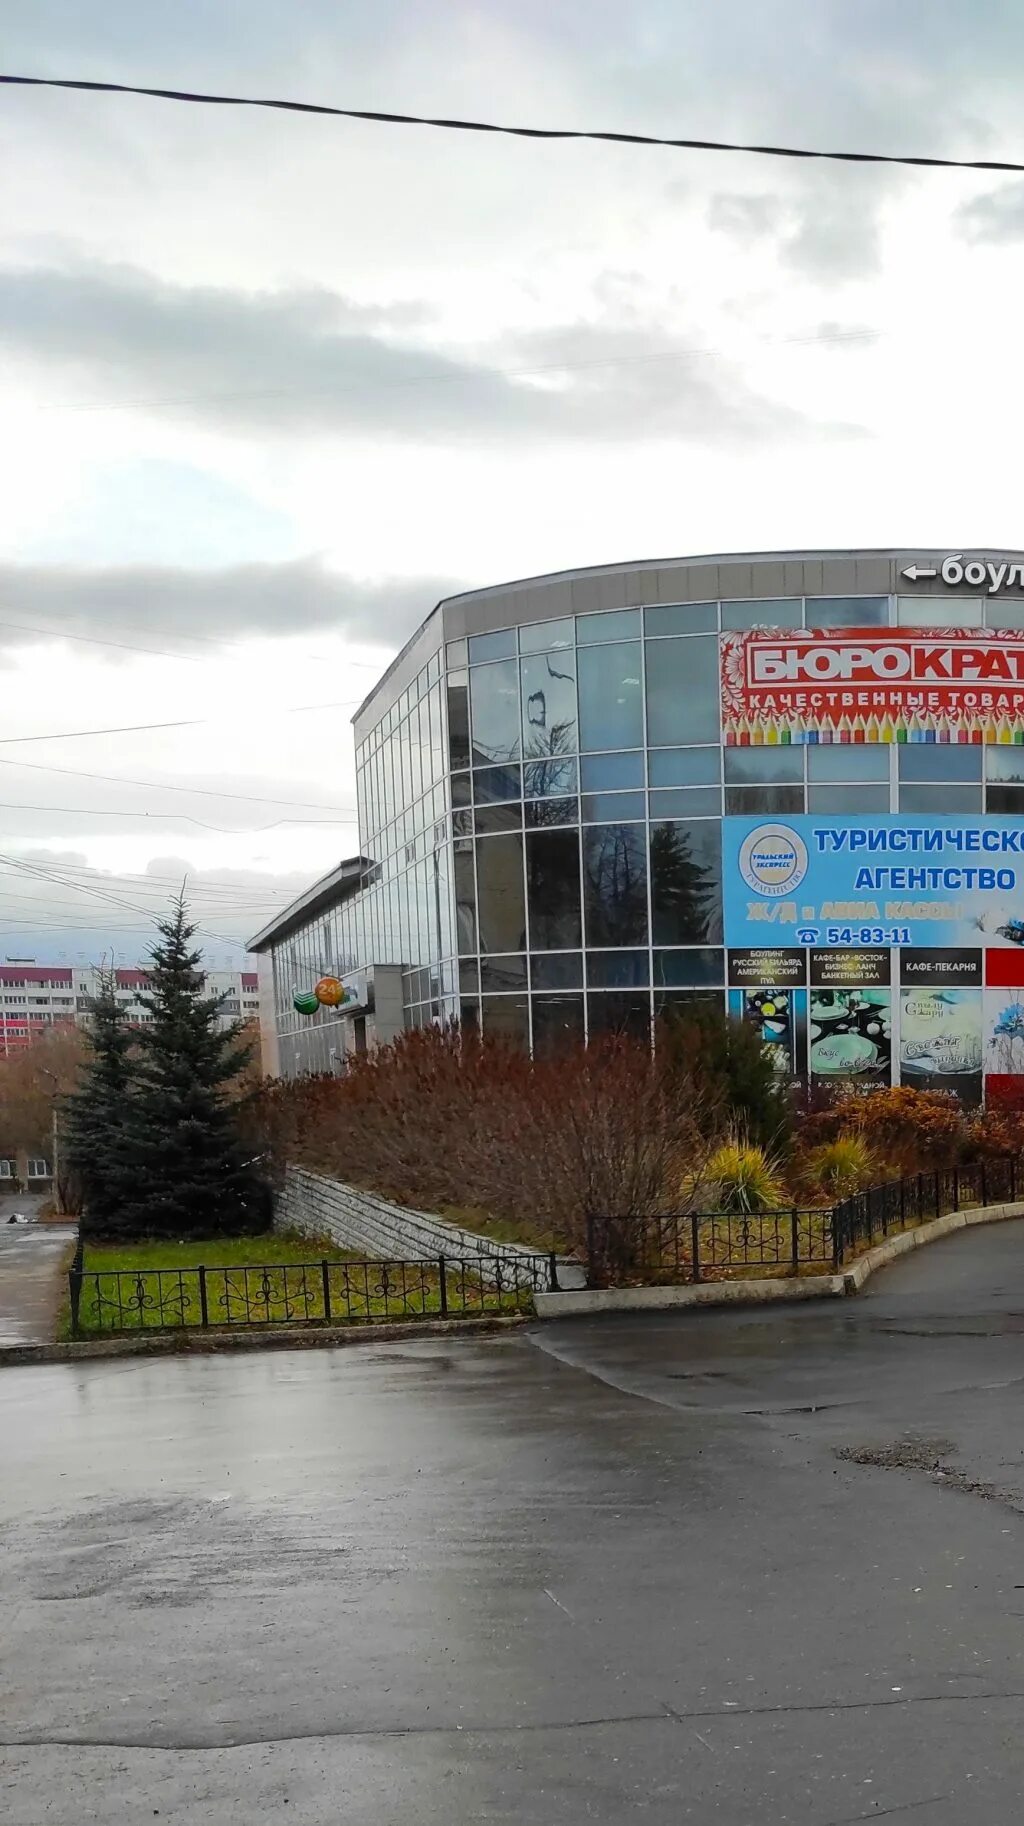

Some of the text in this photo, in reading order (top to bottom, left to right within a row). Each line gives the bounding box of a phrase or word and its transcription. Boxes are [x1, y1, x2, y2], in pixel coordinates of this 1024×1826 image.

[749, 692, 939, 708] КАЧЕСТВЕННЫЕ
[854, 868, 1016, 890] АГЕНТСТВО
[828, 928, 910, 944] 54-83-11
[732, 957, 803, 967] РУССКИЙ БИЛЬЯРД
[906, 962, 977, 972] КАФЕ-ПЕКАРНЯ
[737, 966, 798, 975] АМЕРИКАНСКИЙ
[821, 970, 863, 979] БАНКЕТНЫЙ
[319, 983, 336, 995] 24
